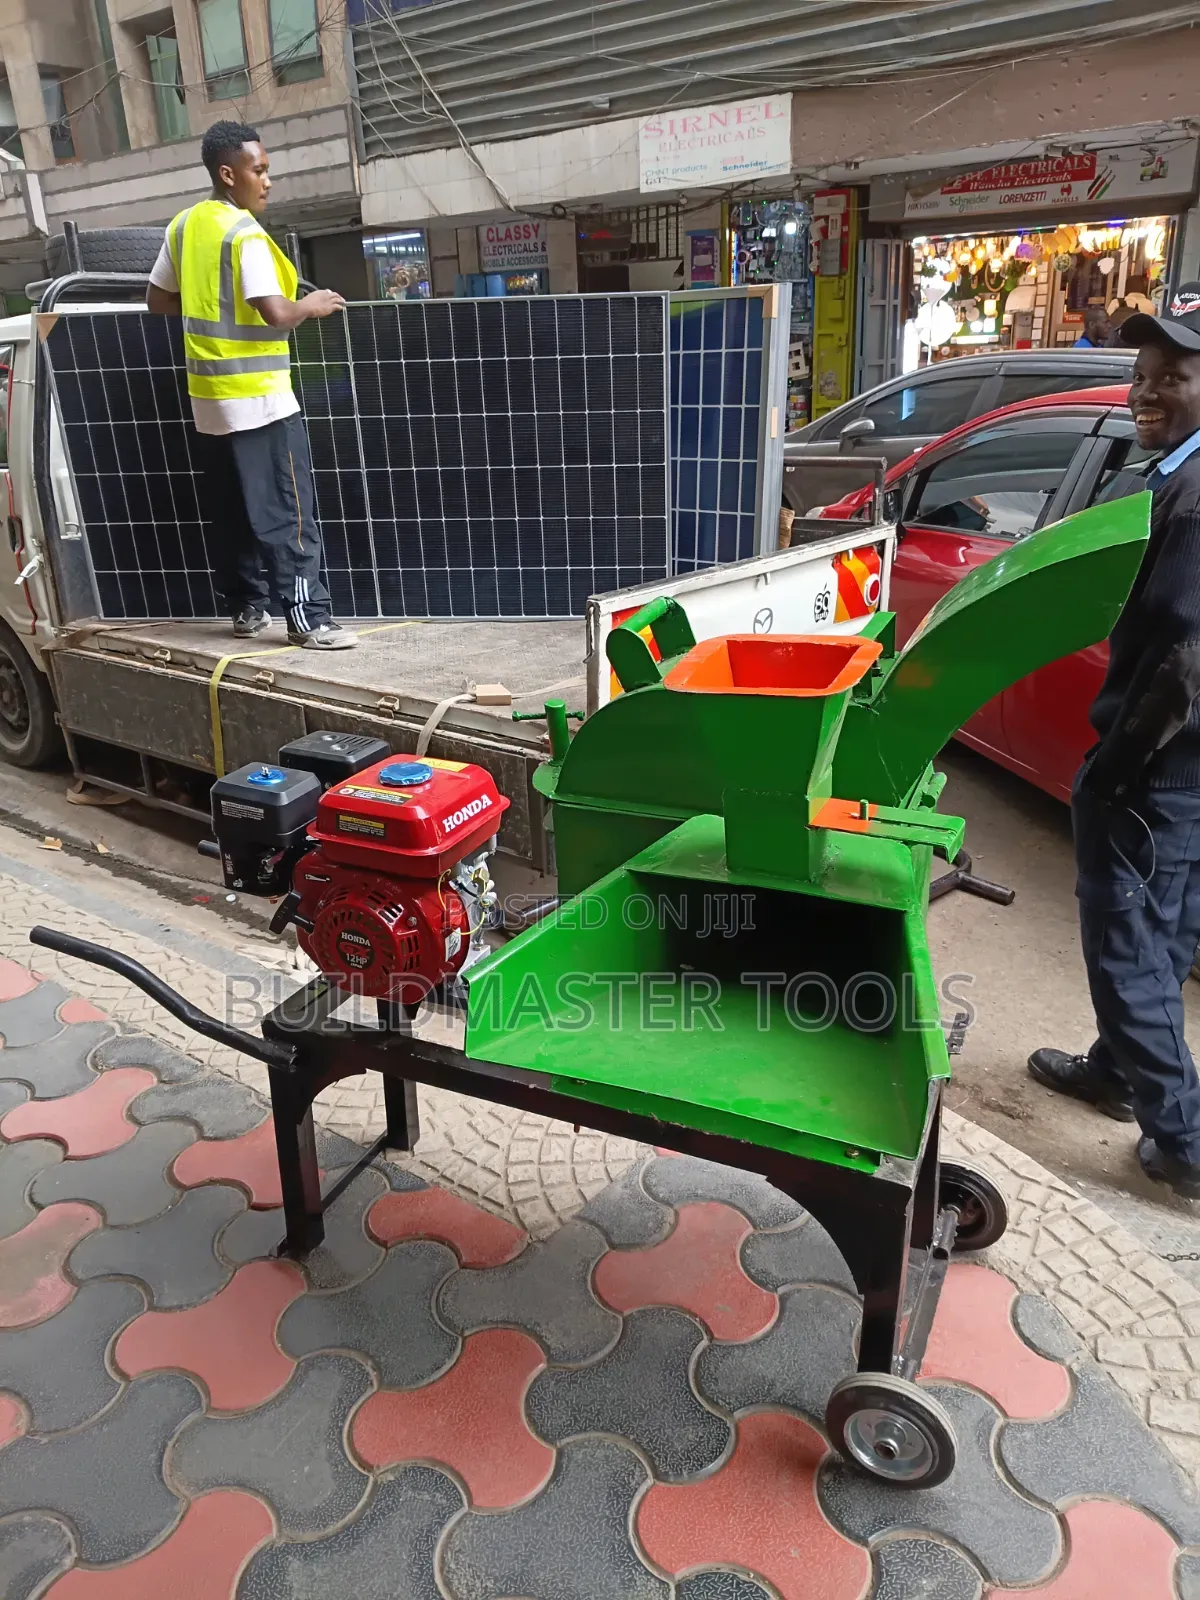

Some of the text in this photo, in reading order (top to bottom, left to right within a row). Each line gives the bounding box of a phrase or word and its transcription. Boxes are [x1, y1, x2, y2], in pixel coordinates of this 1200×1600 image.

[643, 102, 785, 140] SIRNEL
[658, 127, 767, 153] ELECTRICALS
[672, 163, 708, 175] products
[722, 160, 768, 171] Schneider
[992, 155, 1092, 180] ELECTRICALS
[949, 193, 991, 212] Schneider
[999, 191, 1047, 205] LORENZETTI
[486, 223, 540, 243] CLASSY
[483, 241, 548, 257] ELECTRICALS &
[442, 793, 493, 833] HONDA
[341, 931, 371, 947] HONDA
[346, 953, 368, 966] 12HP
